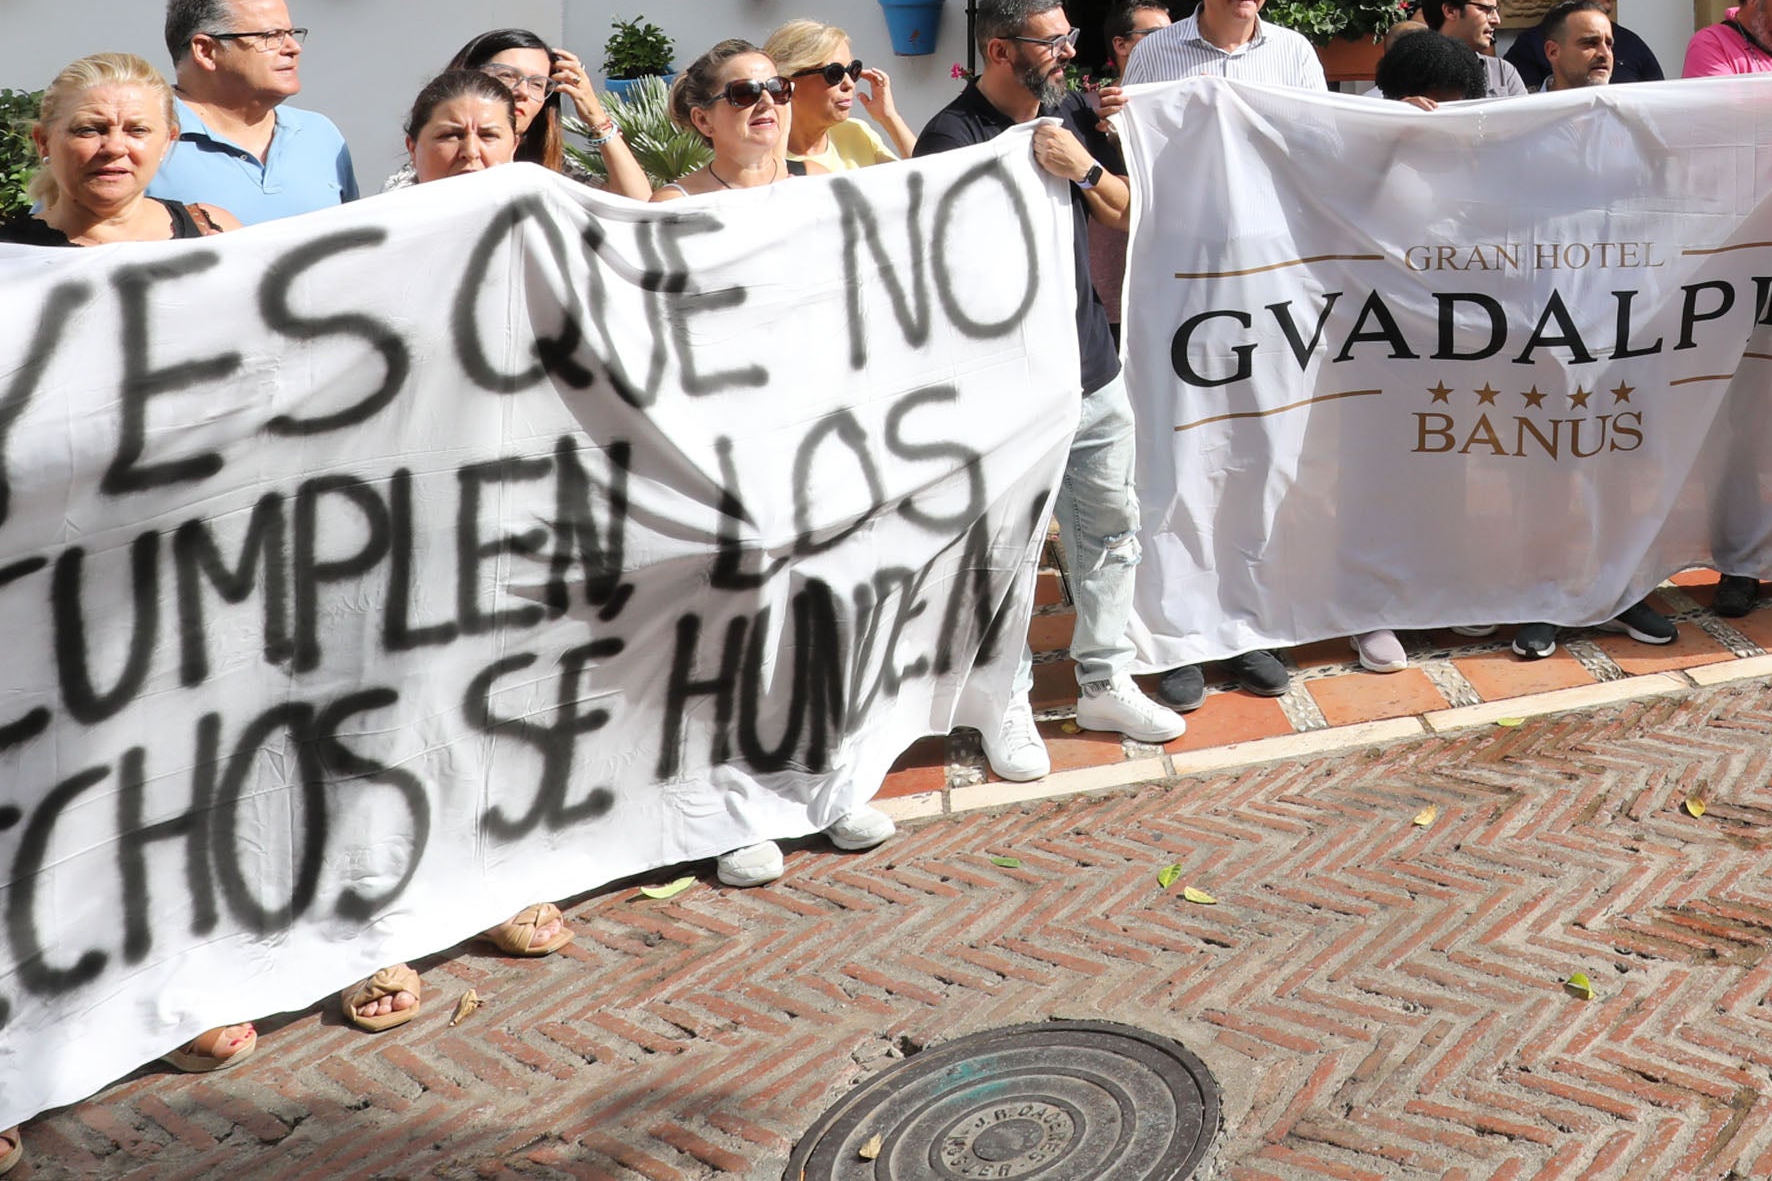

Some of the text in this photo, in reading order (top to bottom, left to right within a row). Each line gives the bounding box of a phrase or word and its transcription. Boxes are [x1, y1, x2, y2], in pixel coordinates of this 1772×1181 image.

[453, 194, 771, 410] QUE
[829, 156, 1041, 371] NO
[1403, 240, 1666, 274] GRAN HOTEL
[708, 383, 988, 591] LOS
[460, 634, 626, 843] SE
